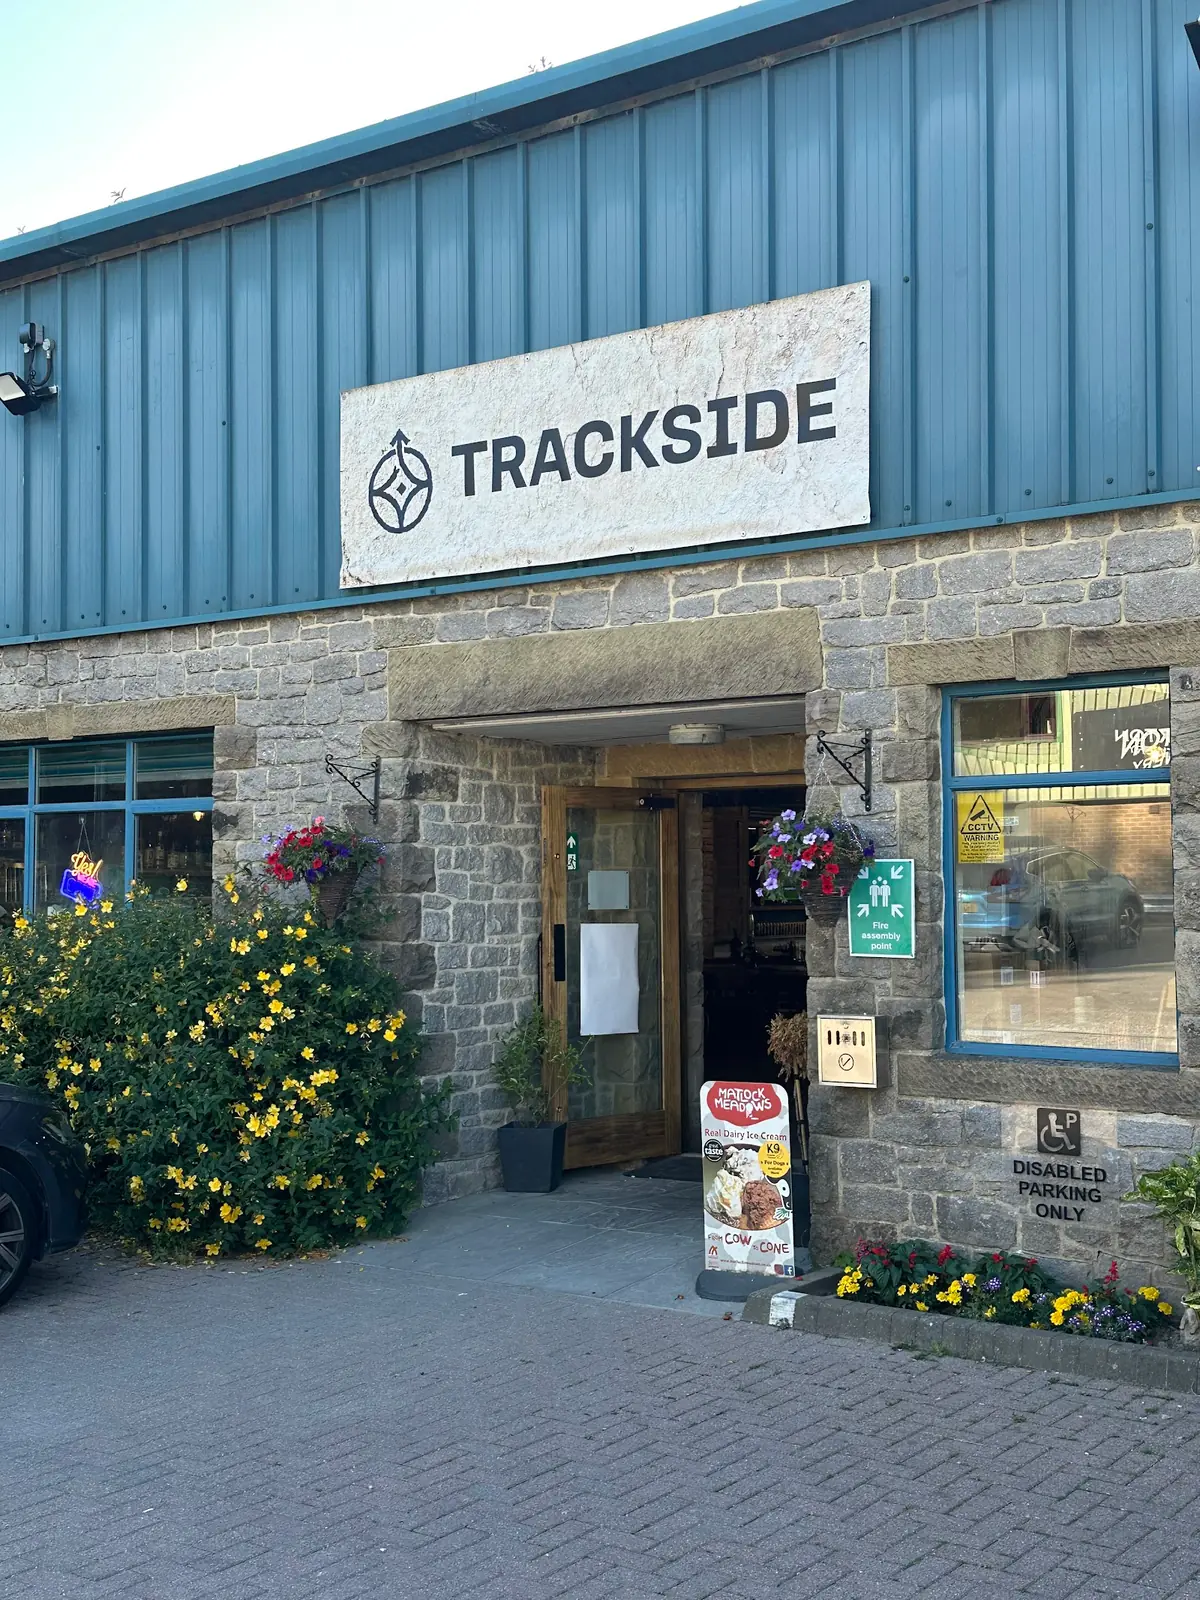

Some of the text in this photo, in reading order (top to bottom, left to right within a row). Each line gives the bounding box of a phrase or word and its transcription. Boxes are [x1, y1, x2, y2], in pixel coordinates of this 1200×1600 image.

[451, 377, 837, 497] TRACKSIDE
[968, 823, 994, 831] CCTV
[872, 921, 889, 929] Fire
[861, 932, 901, 942] assembly
[871, 942, 893, 951] point
[718, 1087, 766, 1102] MATLOCK
[715, 1098, 772, 1112] MEADOWS
[1066, 1113, 1077, 1128] P
[705, 1129, 787, 1141] Real Dairy Ice Cream
[766, 1143, 780, 1154] K9
[1013, 1160, 1107, 1182] DISABLED
[1019, 1181, 1102, 1203] PARKING
[1035, 1203, 1085, 1222] ONLY
[724, 1232, 752, 1246] COW
[759, 1241, 790, 1254] CONE
